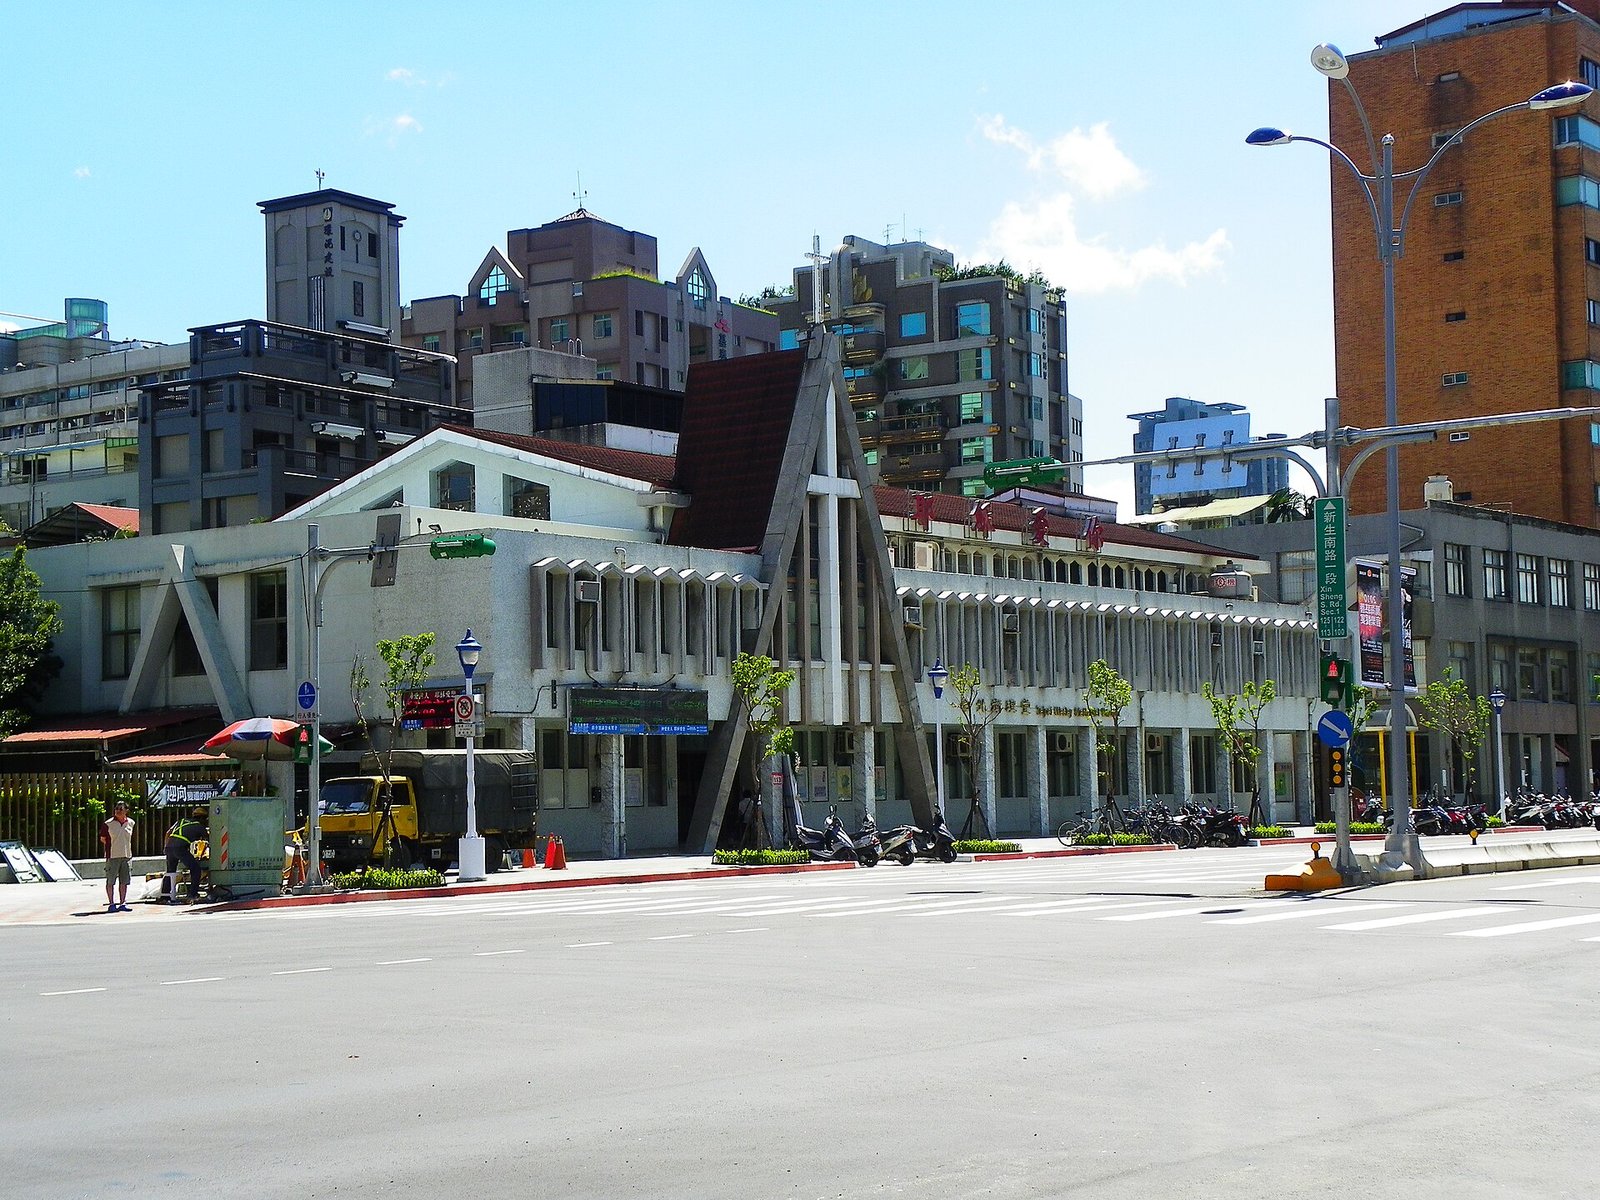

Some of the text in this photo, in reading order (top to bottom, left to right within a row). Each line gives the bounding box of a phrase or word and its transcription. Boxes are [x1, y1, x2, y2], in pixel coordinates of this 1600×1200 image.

[1323, 511, 1337, 585] 新生南路一段
[1320, 593, 1343, 601] Sheng
[1333, 616, 1345, 624] 122
[167, 785, 187, 802] 迎向
